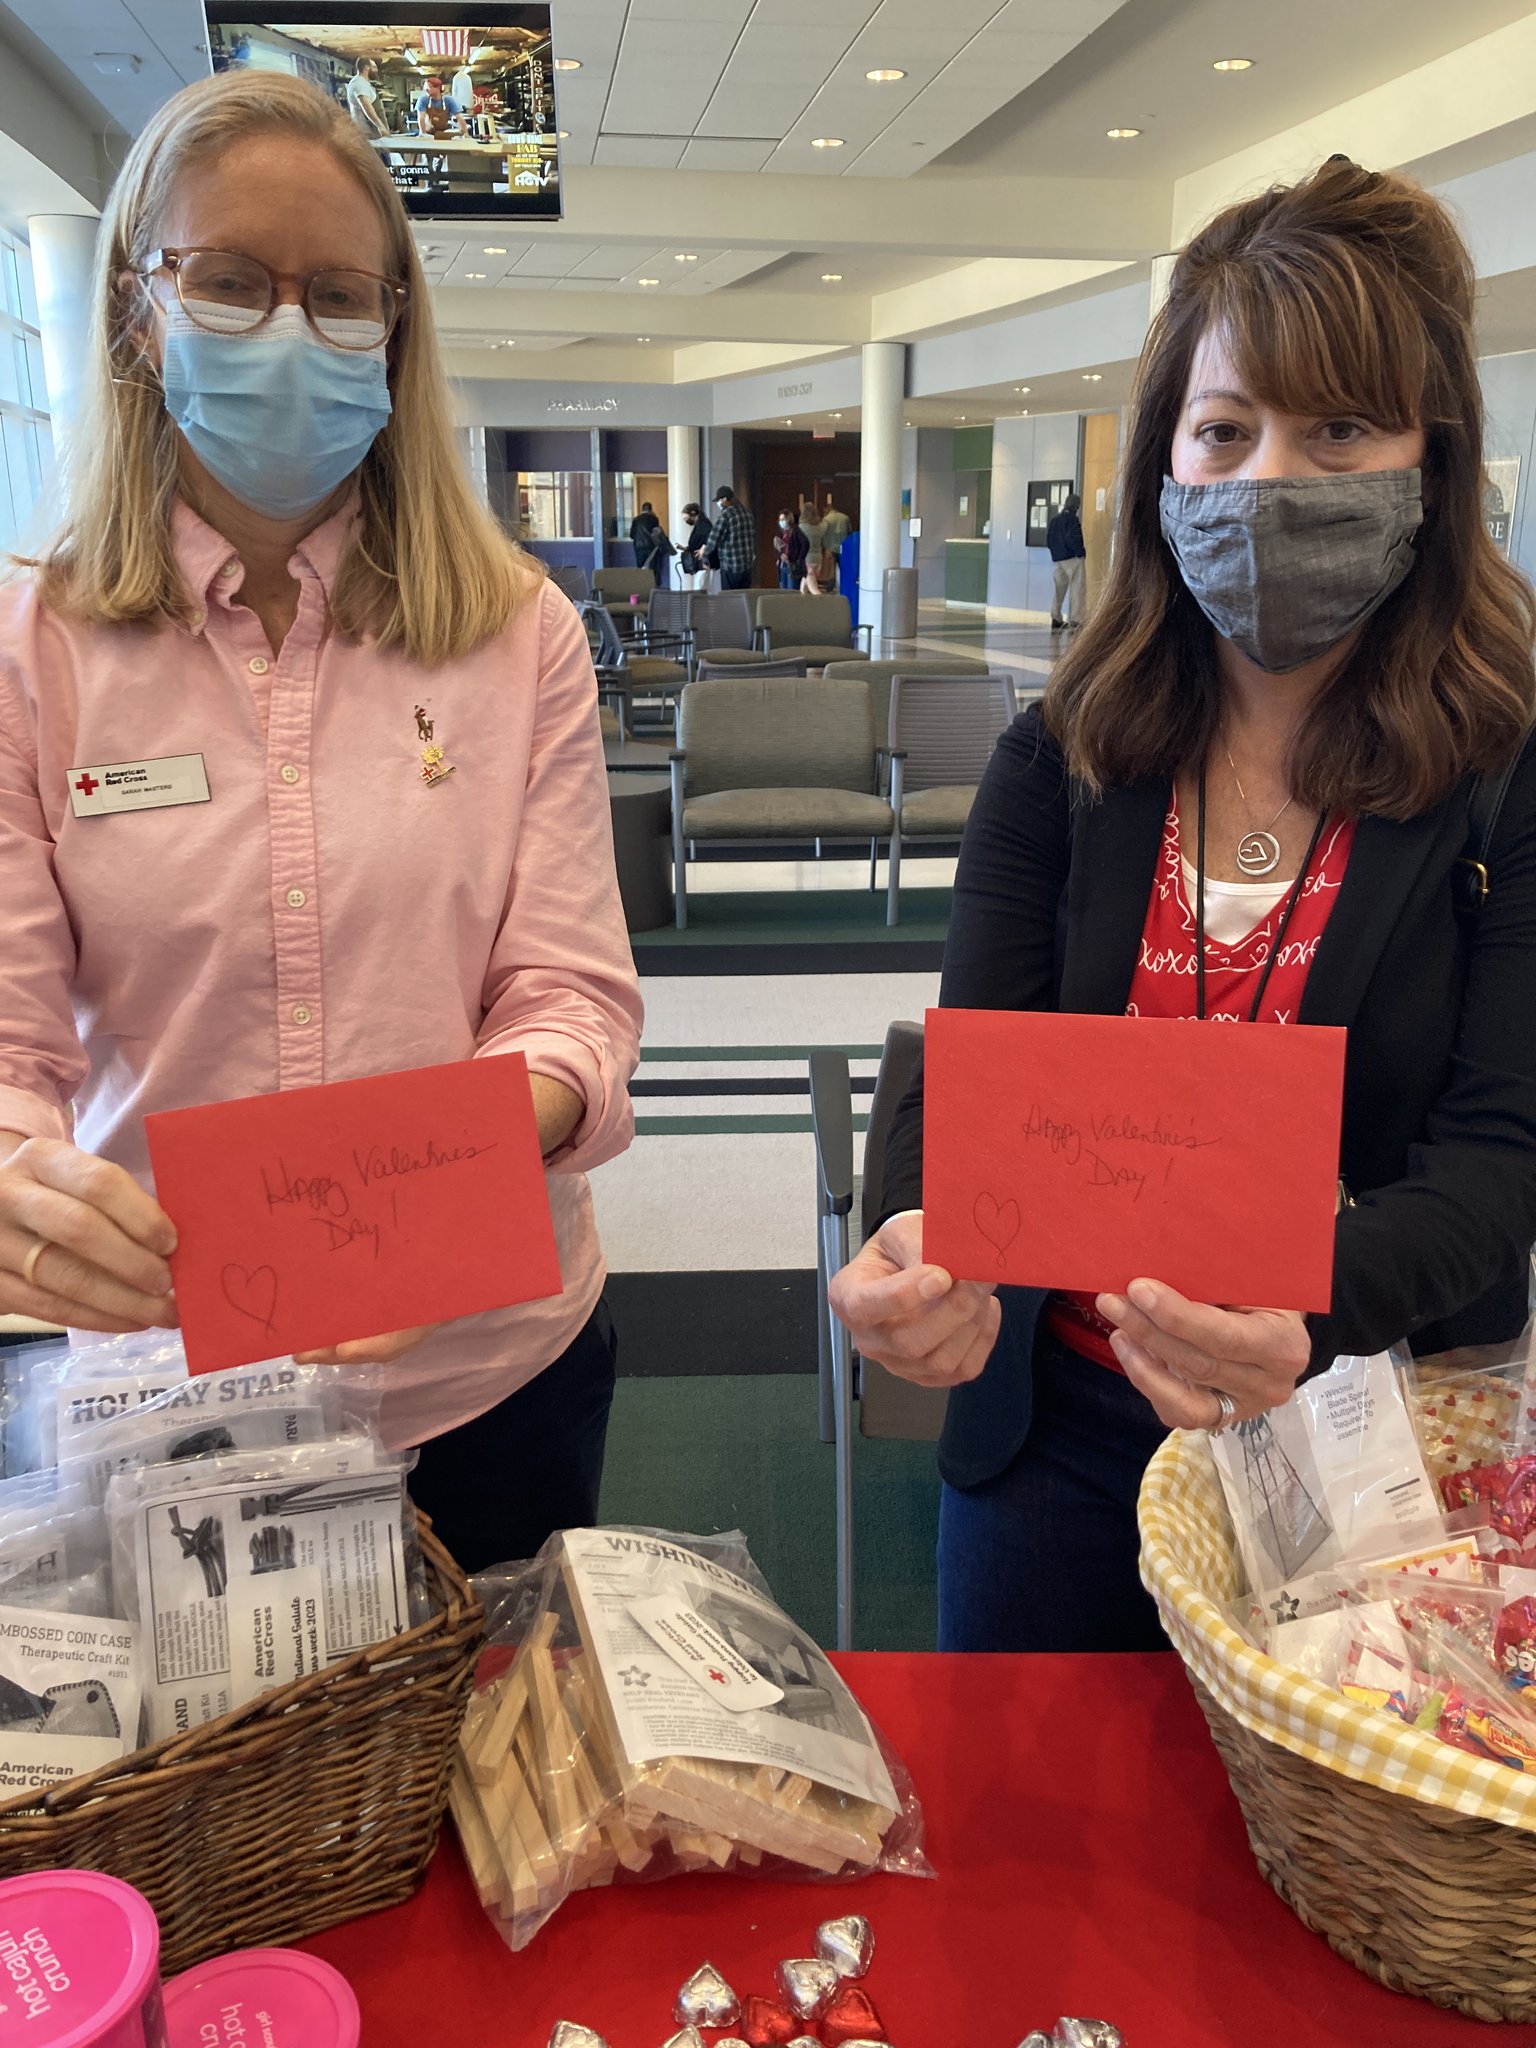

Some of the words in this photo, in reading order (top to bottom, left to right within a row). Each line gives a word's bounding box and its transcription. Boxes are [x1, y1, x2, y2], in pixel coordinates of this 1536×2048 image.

[400, 167, 429, 175] gonna
[514, 176, 549, 187] HGTV
[105, 768, 146, 779] American
[106, 777, 122, 786] Red
[124, 774, 148, 784] Cross
[1022, 1103, 1082, 1165] Happy
[260, 1157, 350, 1218] Happy
[219, 1371, 296, 1403] STAR
[1327, 1395, 1348, 1409] Blade
[1330, 1402, 1357, 1420] Multiple
[1365, 1410, 1374, 1418] To
[604, 1537, 723, 1579] WISHING
[306, 1598, 316, 1625] 2023
[0, 1624, 63, 1642] MBOSSED
[67, 1630, 97, 1645] COIN
[100, 1634, 132, 1649] CASE
[262, 1606, 273, 1648] Cross
[655, 1619, 698, 1662] American
[20, 1645, 84, 1661] Therapeutic
[87, 1651, 112, 1664] Craft
[115, 1655, 130, 1666] Kit
[253, 1607, 264, 1677] American
[265, 1650, 275, 1677] Red
[0, 1761, 73, 1776] American
[22, 1927, 71, 1993] crunch
[15, 1981, 51, 2020] hot
[220, 2002, 247, 2041] hot
